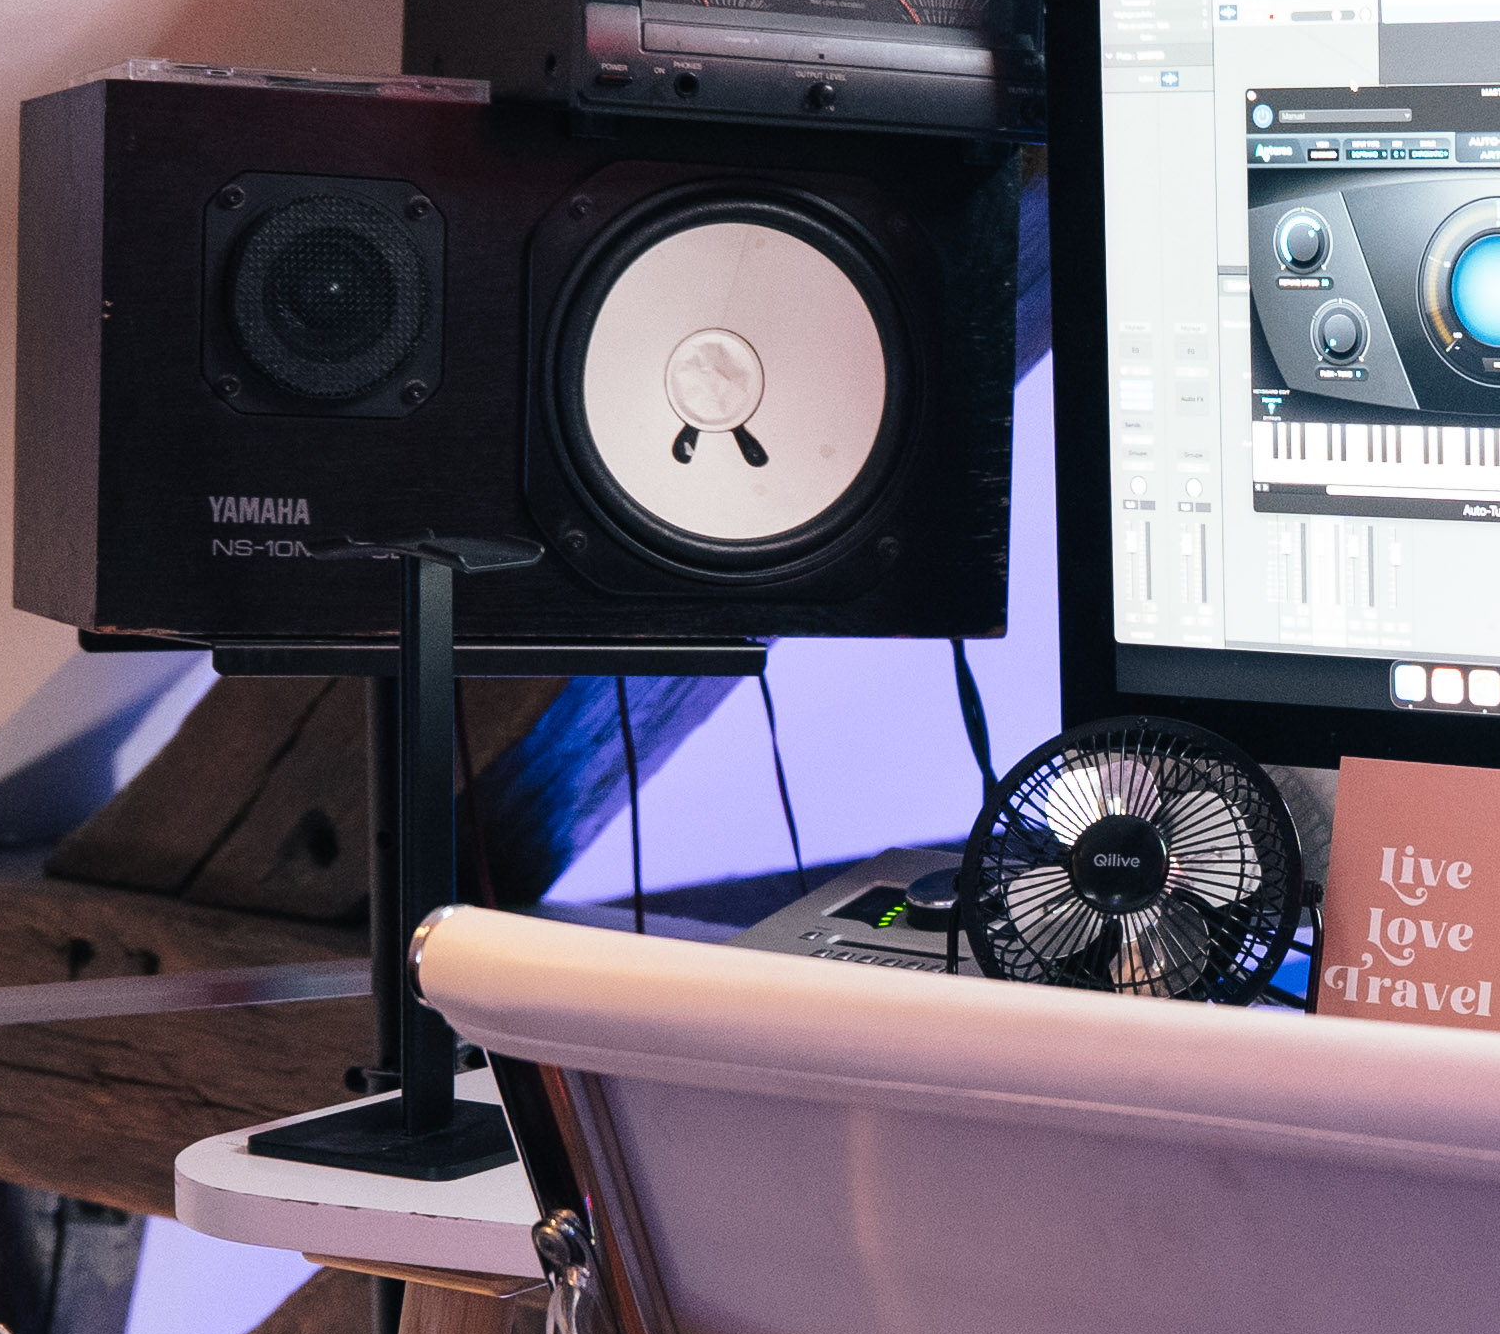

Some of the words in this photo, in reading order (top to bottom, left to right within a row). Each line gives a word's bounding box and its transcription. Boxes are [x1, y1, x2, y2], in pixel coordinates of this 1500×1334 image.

[601, 62, 628, 72] POWER
[653, 66, 667, 75] ON
[795, 70, 824, 80] OUTPUT
[826, 72, 847, 82] LEVEL
[208, 495, 311, 525] YAMAHA
[1093, 851, 1141, 871] Qilive
[1379, 845, 1473, 907] Live
[1366, 907, 1474, 968] Love
[1323, 951, 1493, 1018] Travel
